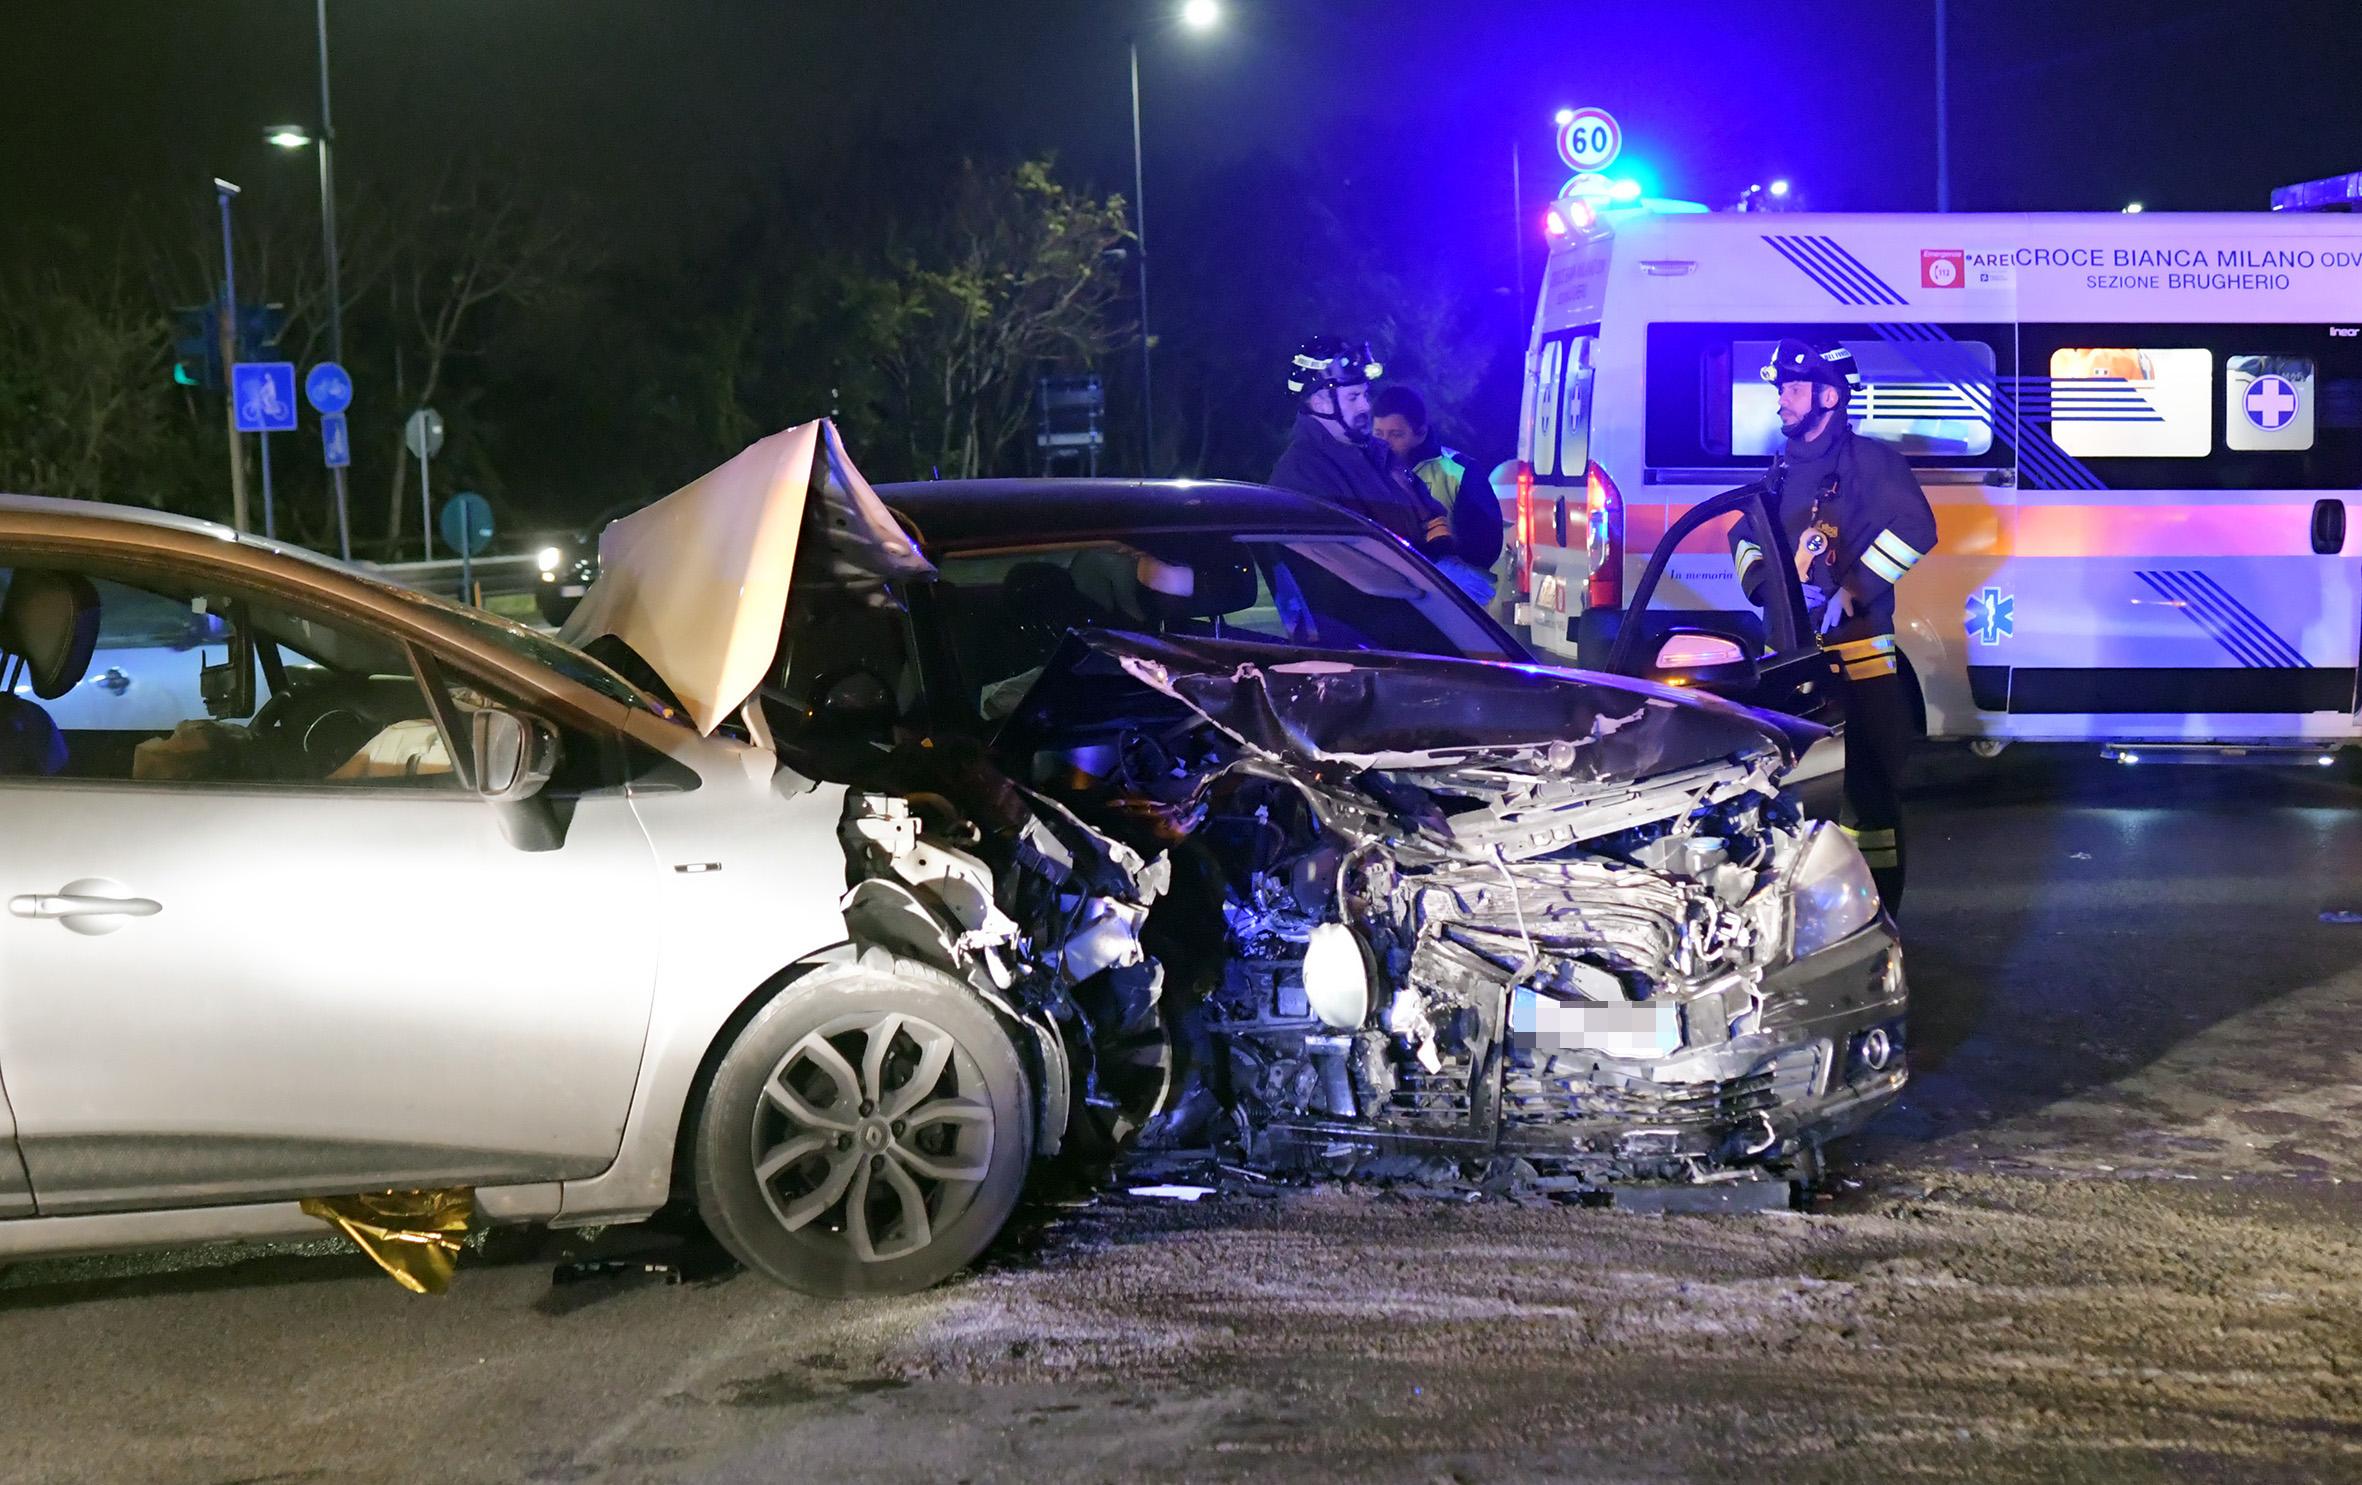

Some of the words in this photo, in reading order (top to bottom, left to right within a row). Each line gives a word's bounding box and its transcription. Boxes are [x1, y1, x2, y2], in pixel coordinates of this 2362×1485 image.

[1572, 126, 1607, 154] 60
[2016, 248, 2104, 267] CROCE
[2113, 249, 2208, 268] BIANCA
[2217, 250, 2315, 268] MILANO
[2320, 251, 2362, 268] ODV
[2087, 275, 2160, 289] SEZIONE
[2168, 273, 2290, 290] BRUGHERIO
